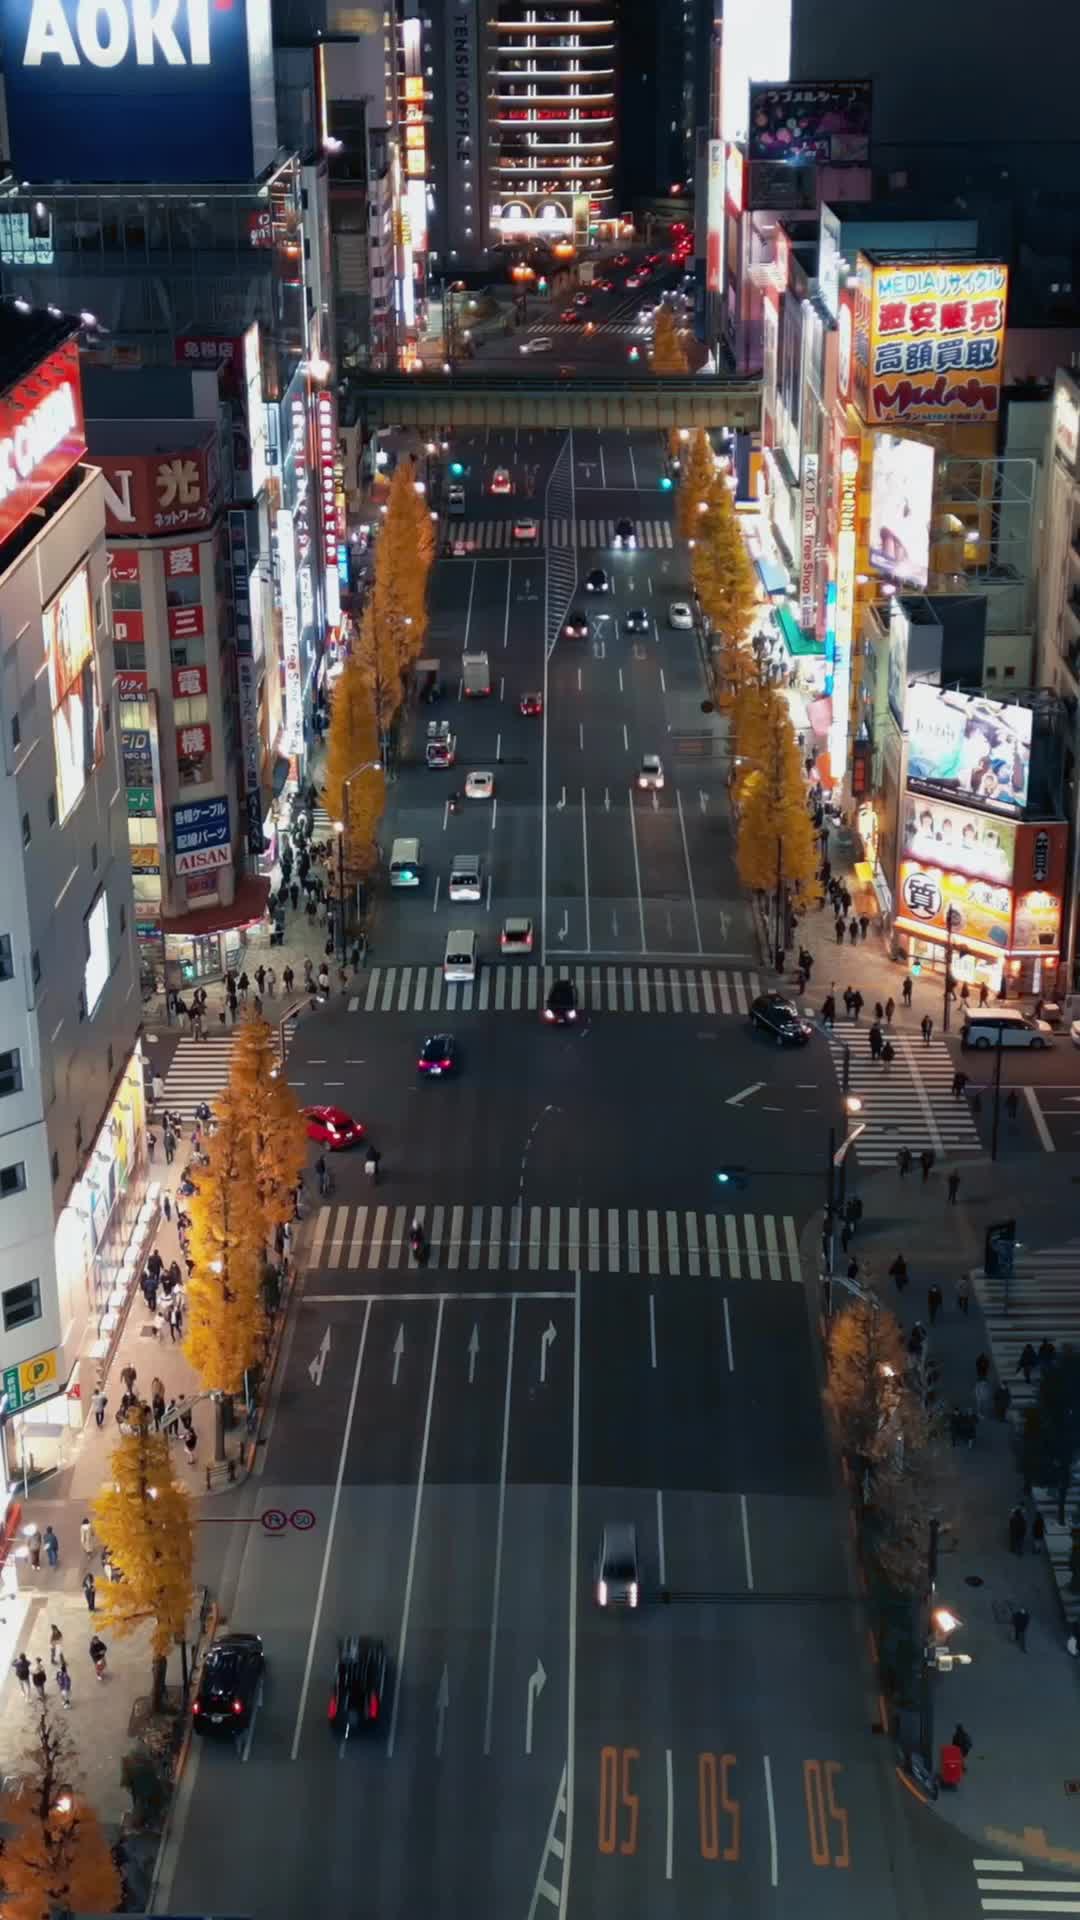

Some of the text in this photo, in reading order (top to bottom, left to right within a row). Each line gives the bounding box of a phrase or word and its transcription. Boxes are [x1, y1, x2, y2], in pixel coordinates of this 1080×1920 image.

[23, 0, 212, 67] AOKI
[878, 300, 1000, 332] 激安販売
[874, 338, 998, 374] 高額買取
[155, 459, 201, 506] 光
[154, 508, 209, 527] ネットワーク
[802, 562, 815, 594] Shop
[175, 803, 226, 825] 各種ケーブル
[176, 827, 227, 848] 配線パーツ
[178, 851, 229, 871] AISAN
